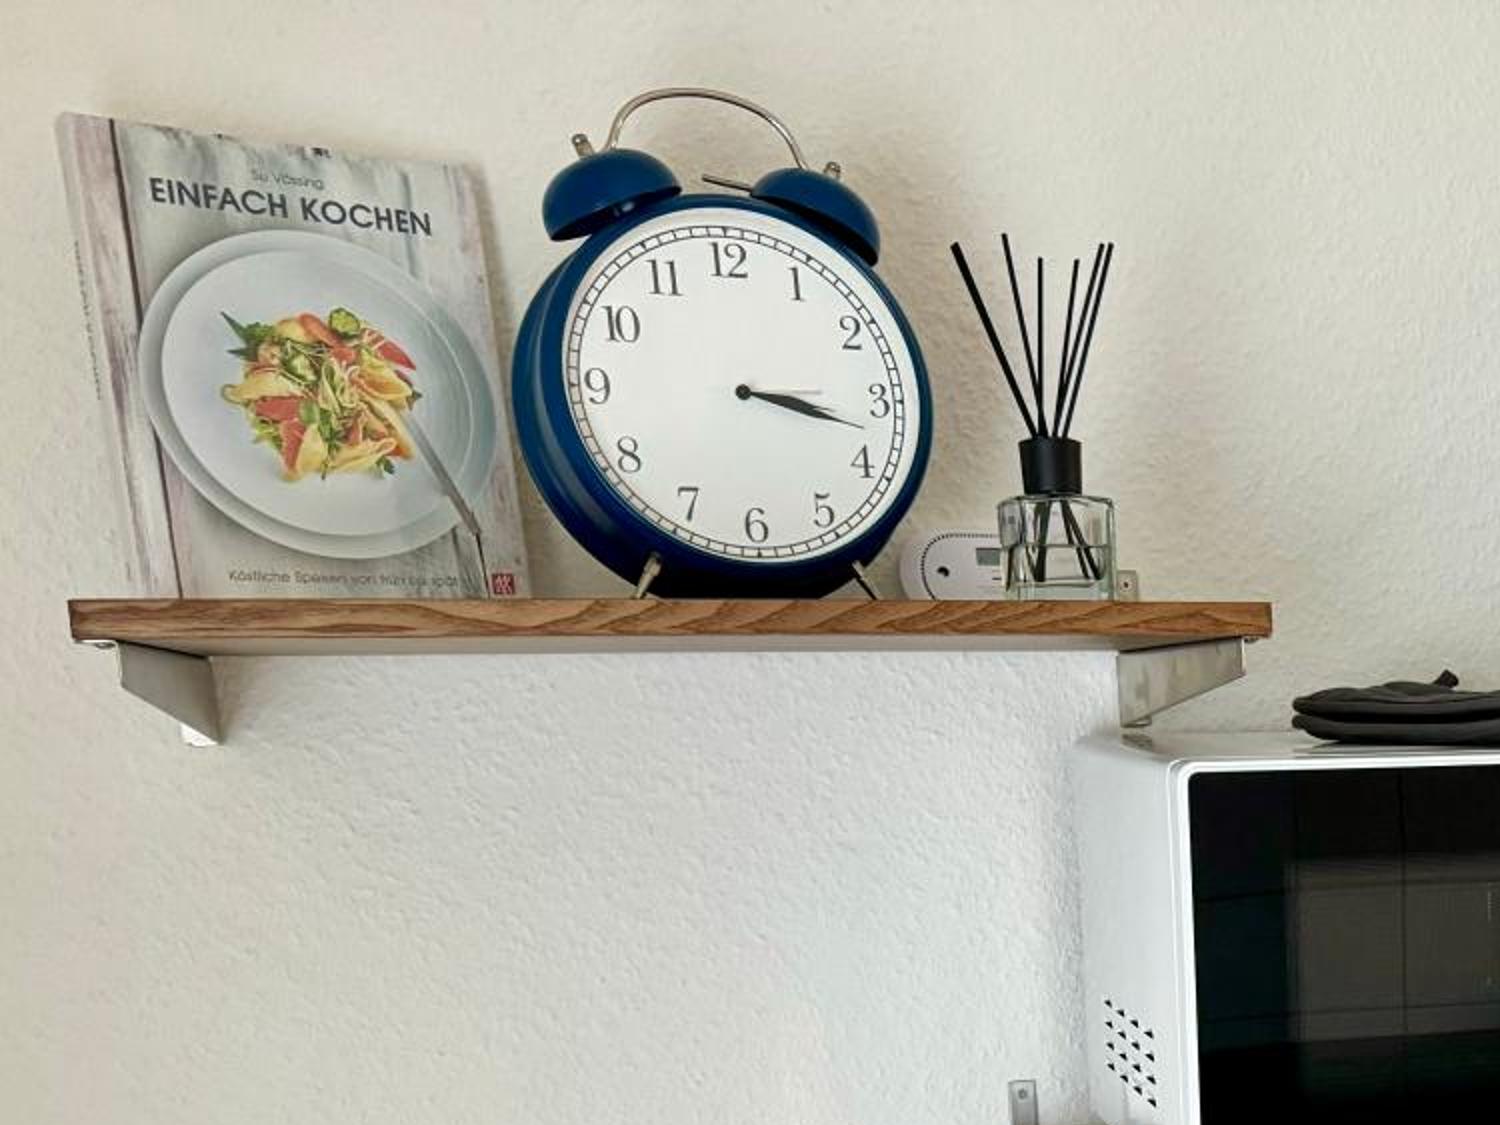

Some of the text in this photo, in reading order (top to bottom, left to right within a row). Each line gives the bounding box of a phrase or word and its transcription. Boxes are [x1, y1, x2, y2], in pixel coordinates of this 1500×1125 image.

[149, 177, 431, 236] EINFACH KOCHEN
[646, 258, 683, 297] 11
[709, 241, 748, 279] 12
[788, 266, 806, 302] 1
[601, 305, 641, 343] 10
[839, 315, 863, 351] 2
[583, 367, 611, 405] 9
[868, 383, 891, 419] 3
[616, 435, 642, 474] 8
[850, 444, 876, 480] 4
[676, 486, 700, 522] 7
[812, 492, 836, 529] 5
[744, 507, 770, 544] 6
